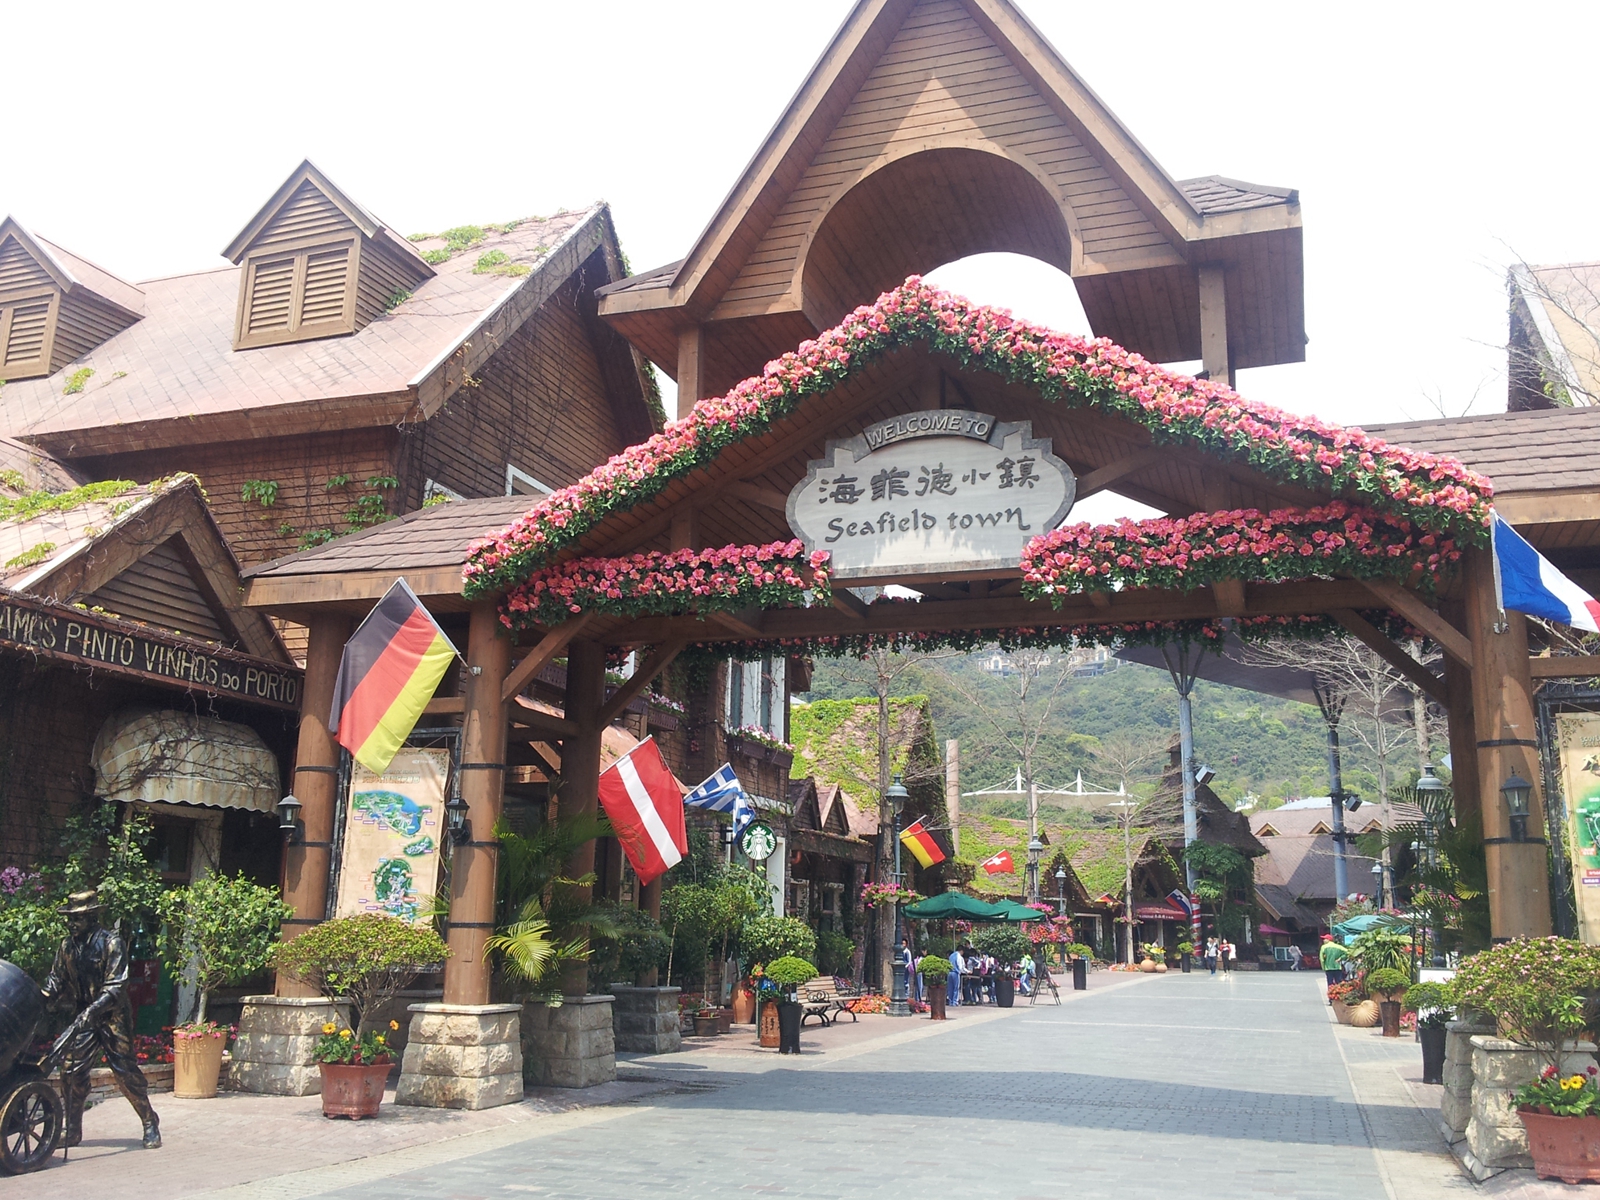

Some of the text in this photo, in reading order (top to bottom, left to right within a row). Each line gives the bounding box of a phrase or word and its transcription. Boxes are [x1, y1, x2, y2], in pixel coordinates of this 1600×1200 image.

[867, 416, 989, 446] WELCOME TO
[825, 507, 1031, 543] Seafield town
[65, 622, 134, 666] PINTO
[144, 642, 218, 684] VINHOS
[245, 667, 296, 703] PORTO
